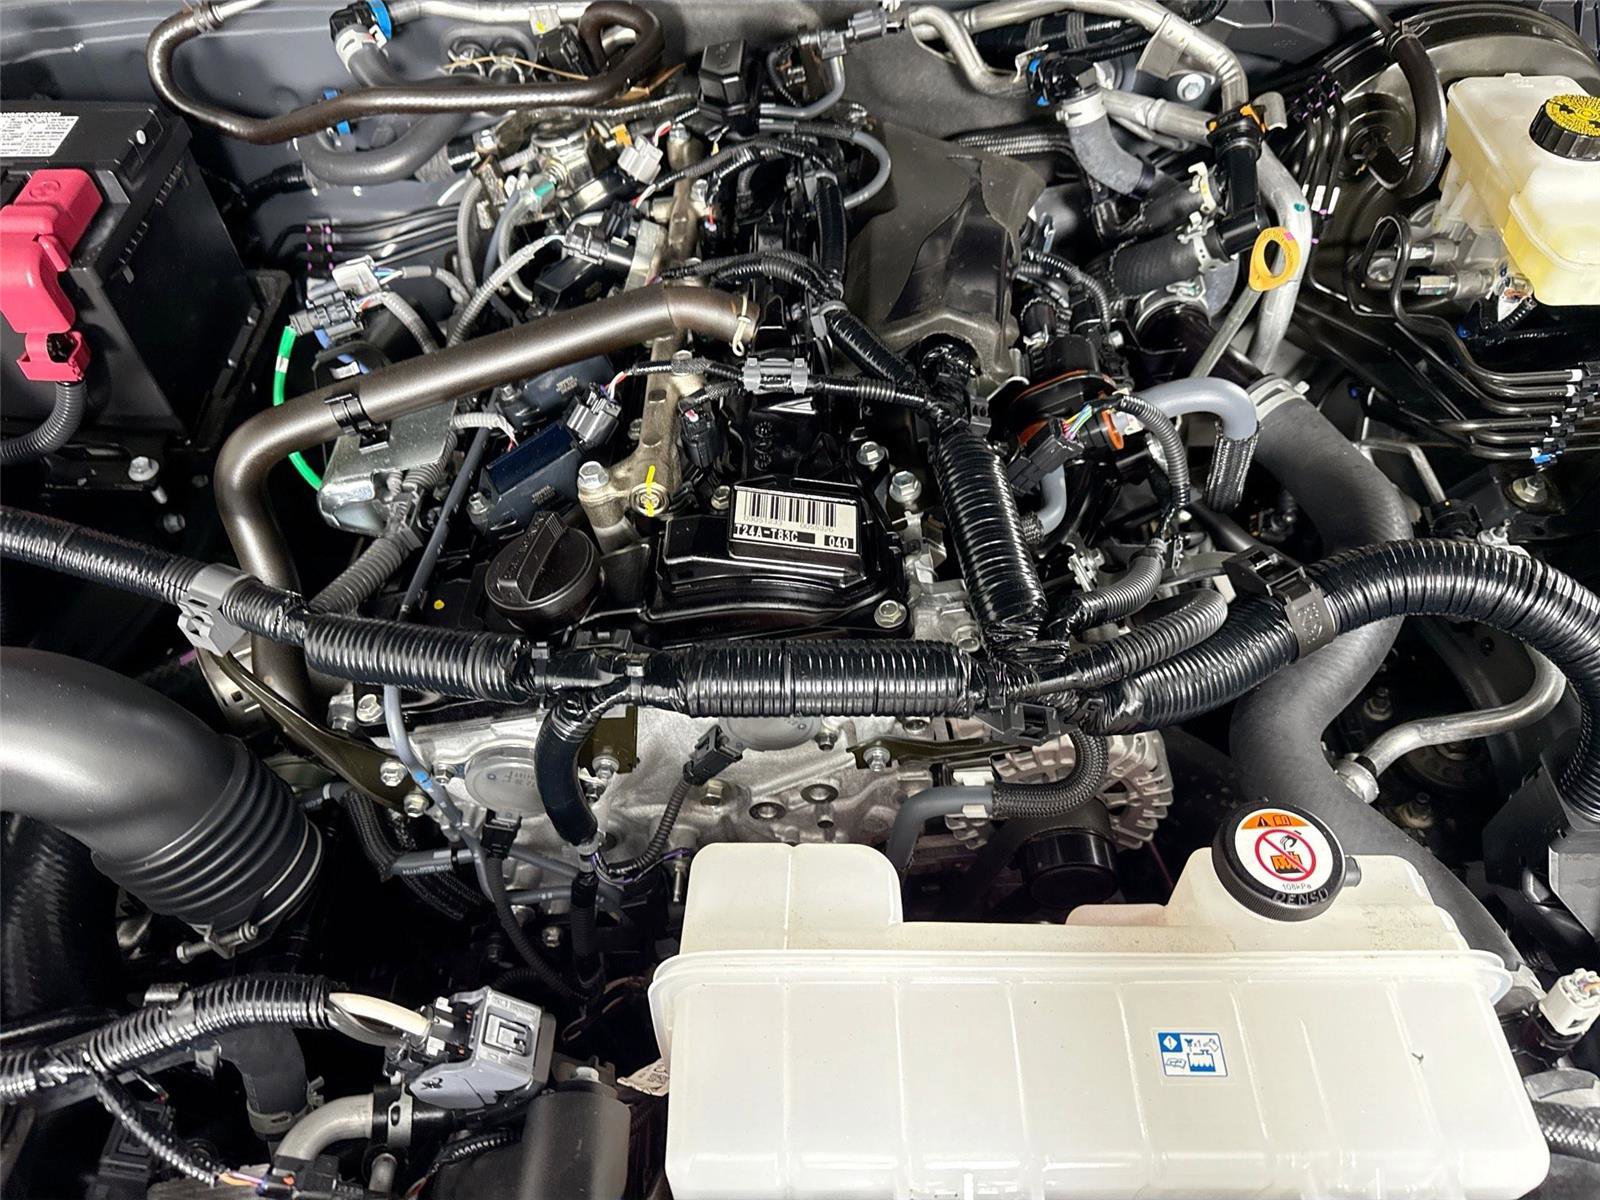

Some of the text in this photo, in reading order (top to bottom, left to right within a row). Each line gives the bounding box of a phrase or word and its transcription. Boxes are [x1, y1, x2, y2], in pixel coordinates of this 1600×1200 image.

[735, 523, 850, 549] T24A-T83C 040
[1271, 887, 1329, 906] DENSO
